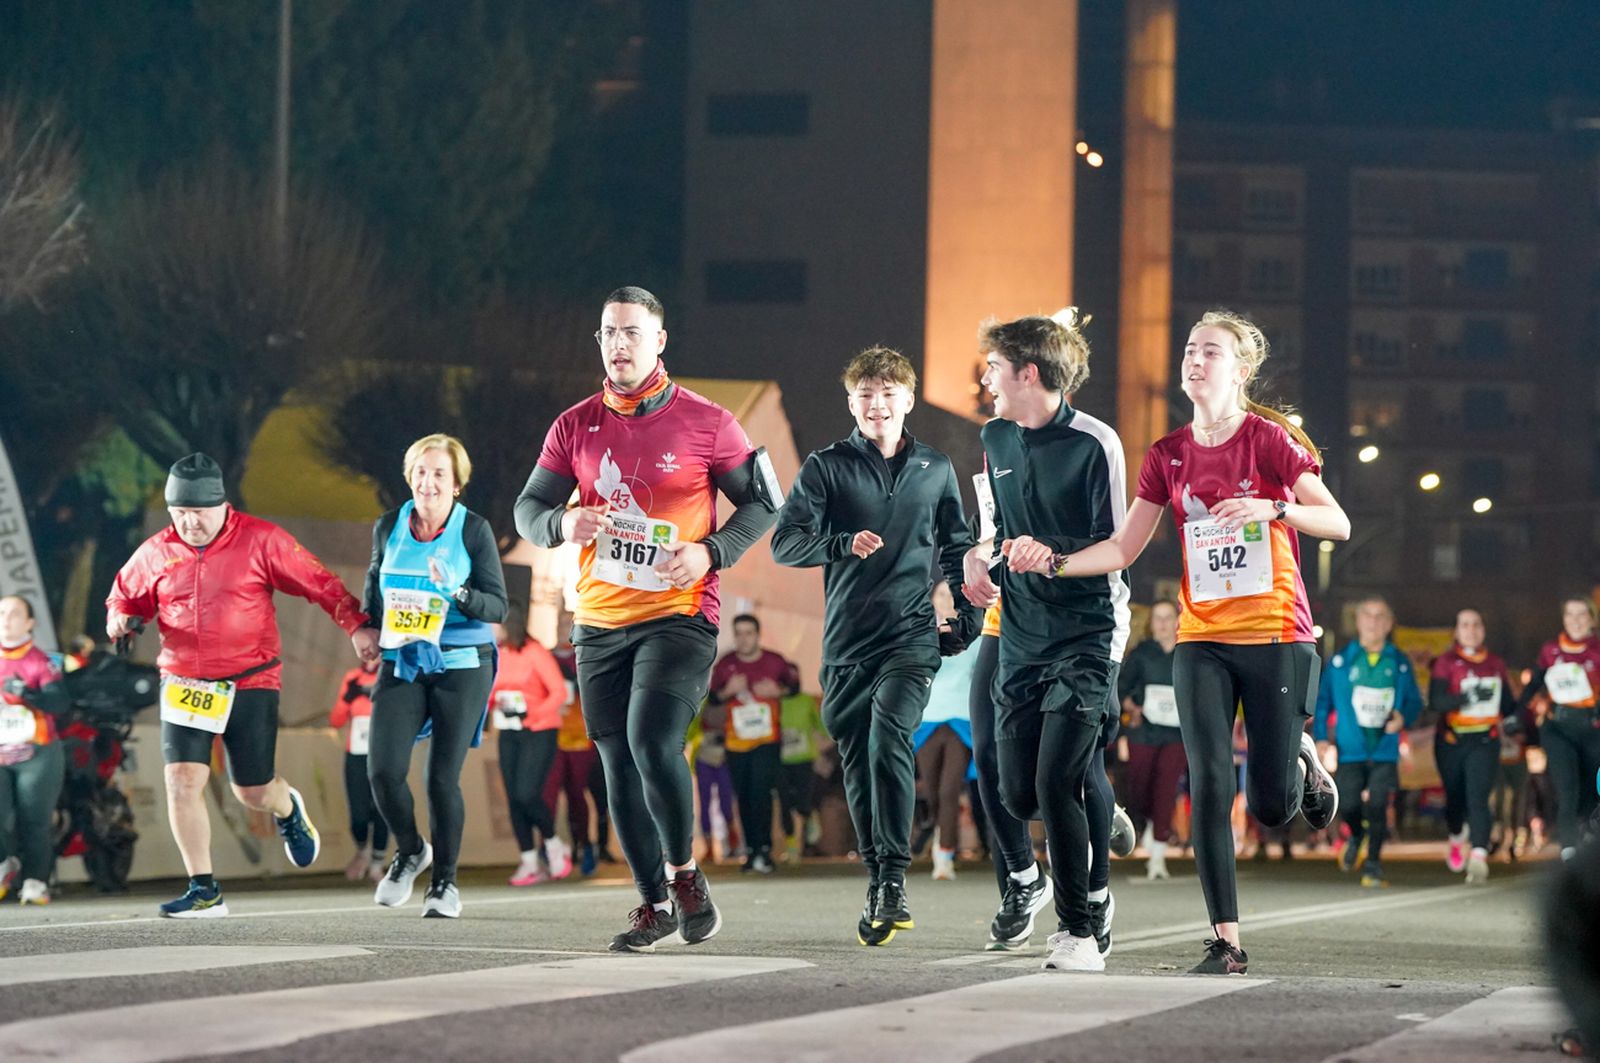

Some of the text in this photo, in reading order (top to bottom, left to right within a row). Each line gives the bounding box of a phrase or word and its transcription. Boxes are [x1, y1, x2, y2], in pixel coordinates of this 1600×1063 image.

[610, 489, 631, 509] 43
[604, 526, 619, 537] SAN
[613, 520, 636, 531] NOCHE
[637, 525, 647, 533] DE
[610, 538, 657, 566] 3167
[1195, 538, 1209, 549] SAN
[1208, 545, 1247, 572] 542
[180, 688, 214, 710] 268
